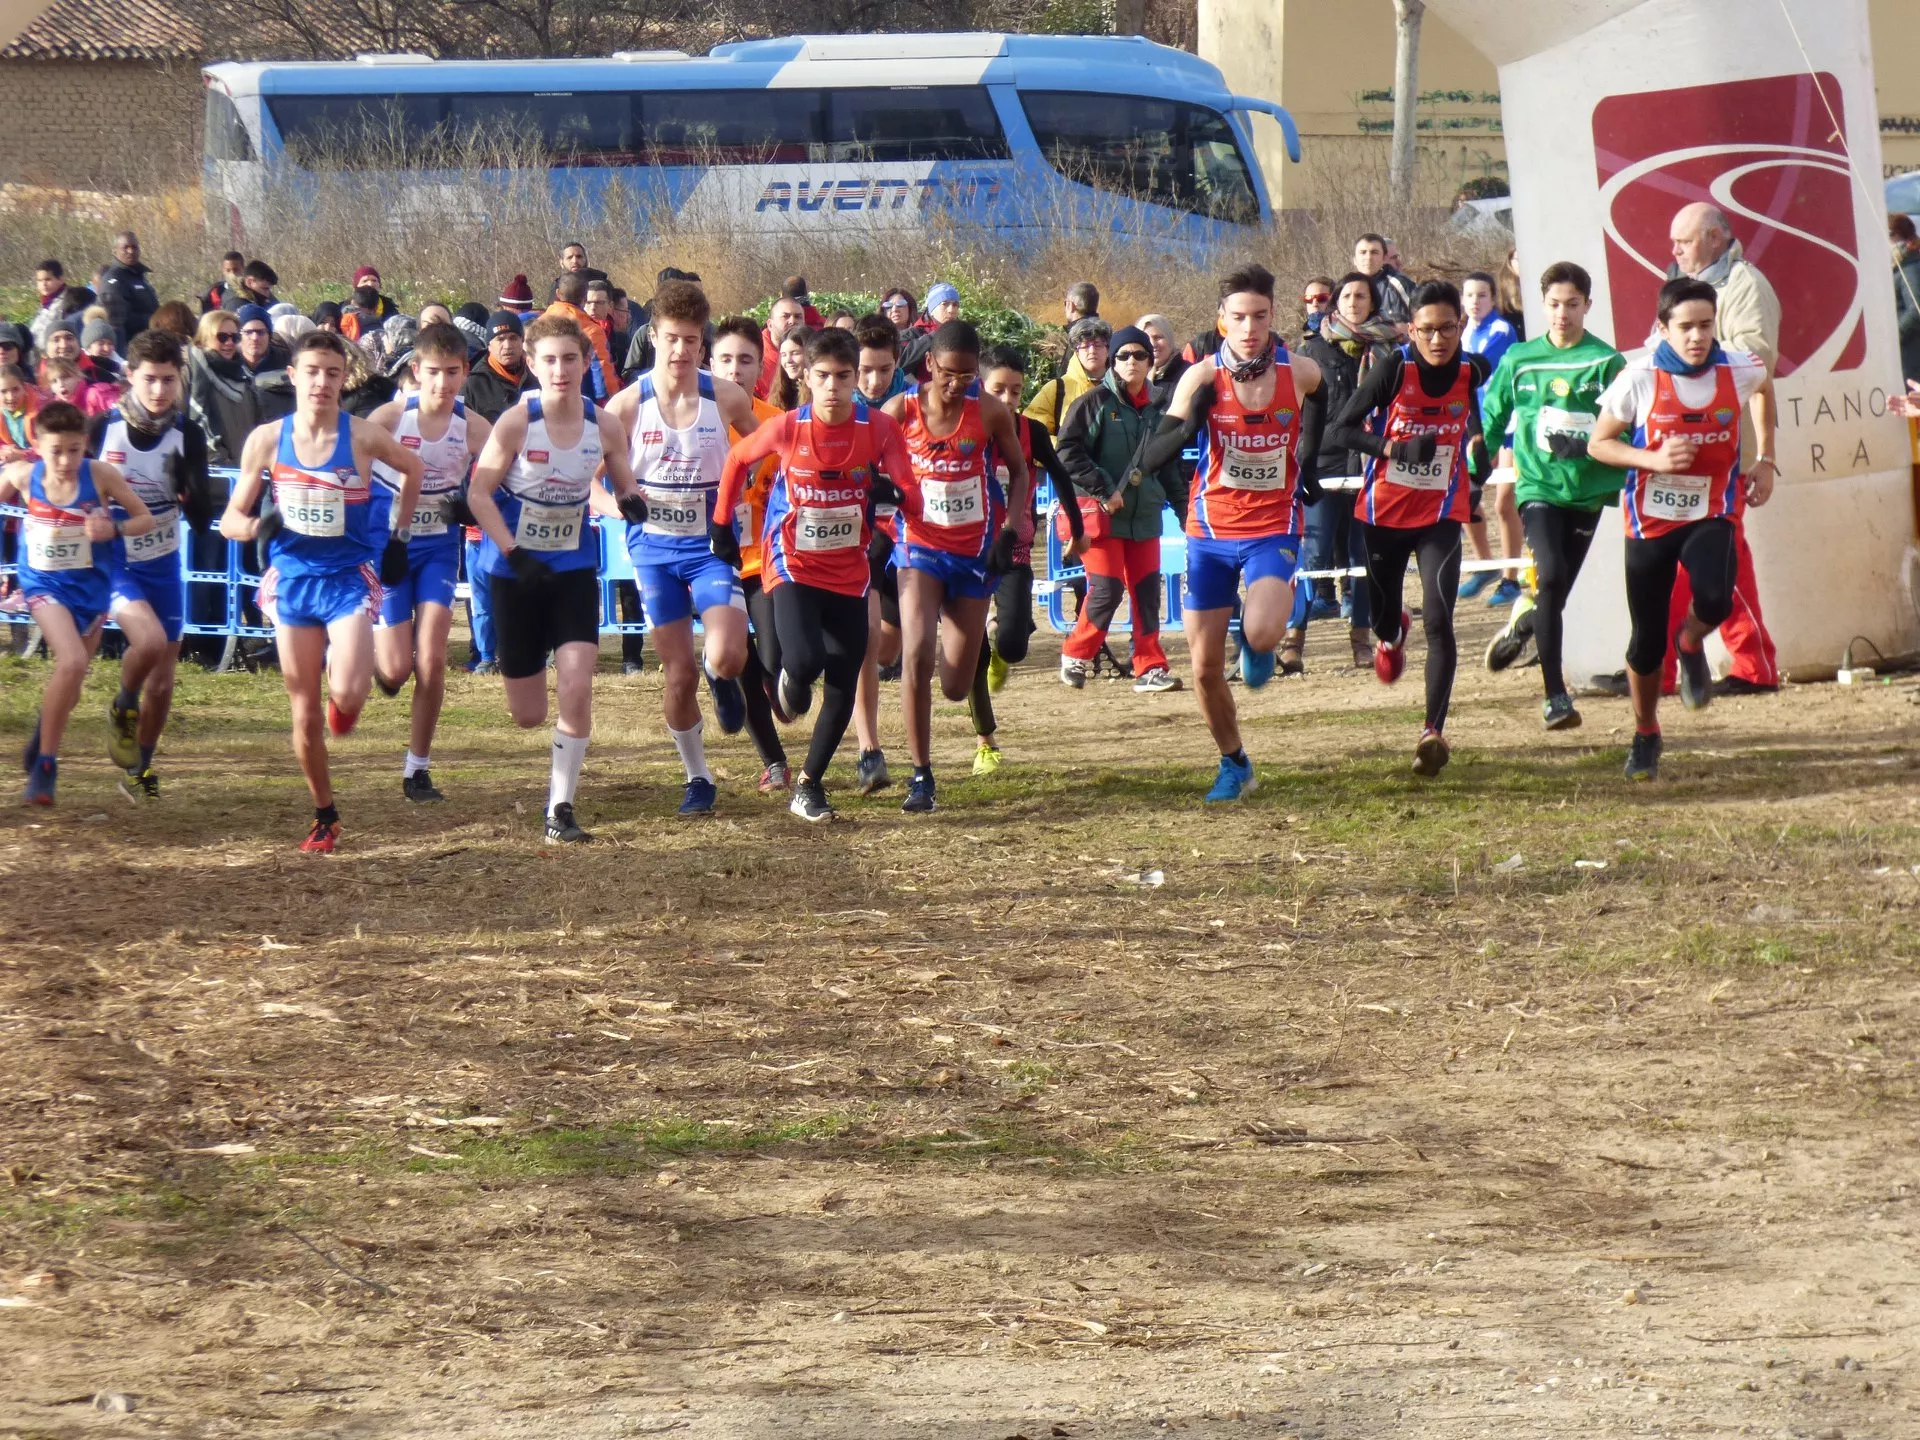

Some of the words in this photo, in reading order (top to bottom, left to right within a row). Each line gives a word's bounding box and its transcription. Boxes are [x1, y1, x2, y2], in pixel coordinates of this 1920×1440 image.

[1391, 416, 1460, 435] hinaco
[1217, 430, 1290, 448] hinaco
[1228, 465, 1278, 480] 5632
[1395, 461, 1442, 477] 5636
[793, 483, 864, 502] hinaco
[1652, 489, 1700, 507] 5638
[930, 496, 974, 513] 5635
[287, 505, 334, 523] 5655
[411, 511, 441, 524] 507
[650, 507, 697, 523] 5509
[525, 522, 573, 538] 5510
[804, 523, 852, 538] 5640
[133, 527, 175, 551] 5514
[36, 543, 81, 558] 5657
